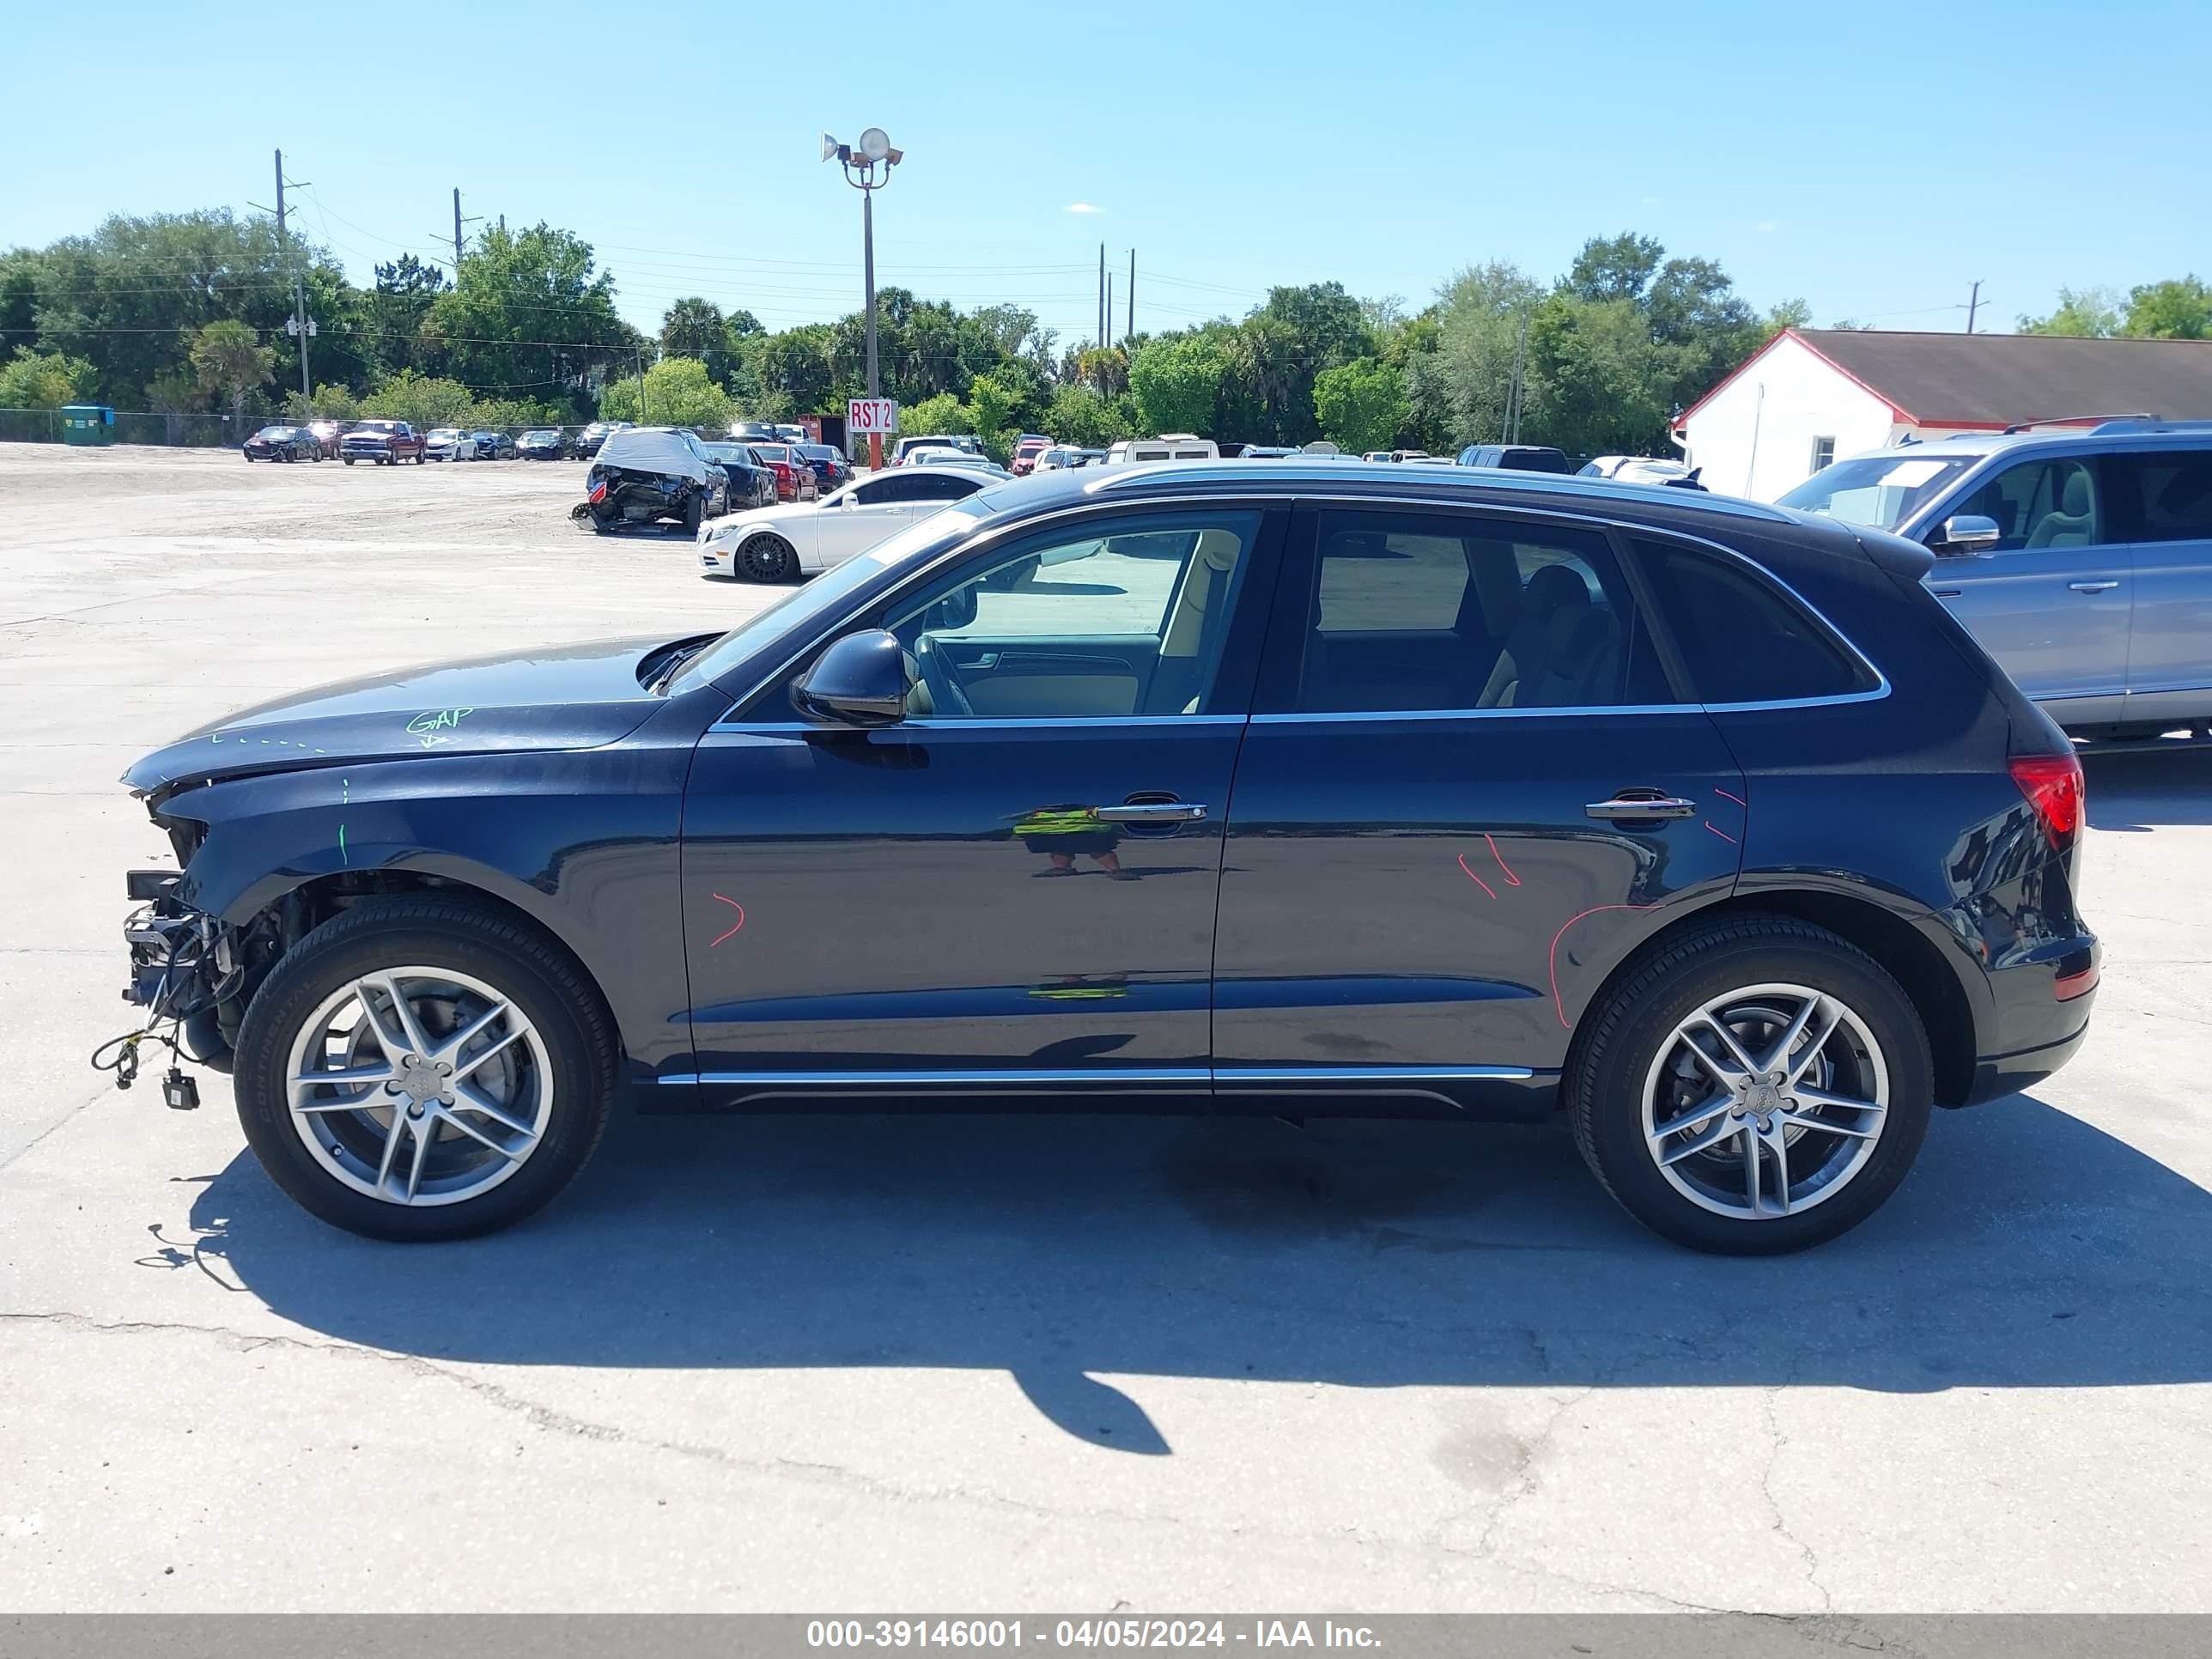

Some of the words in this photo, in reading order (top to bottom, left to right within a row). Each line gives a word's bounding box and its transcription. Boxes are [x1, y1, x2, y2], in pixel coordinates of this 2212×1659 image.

[852, 402, 879, 428] RST
[884, 402, 891, 428] 2
[406, 707, 474, 733] GAP
